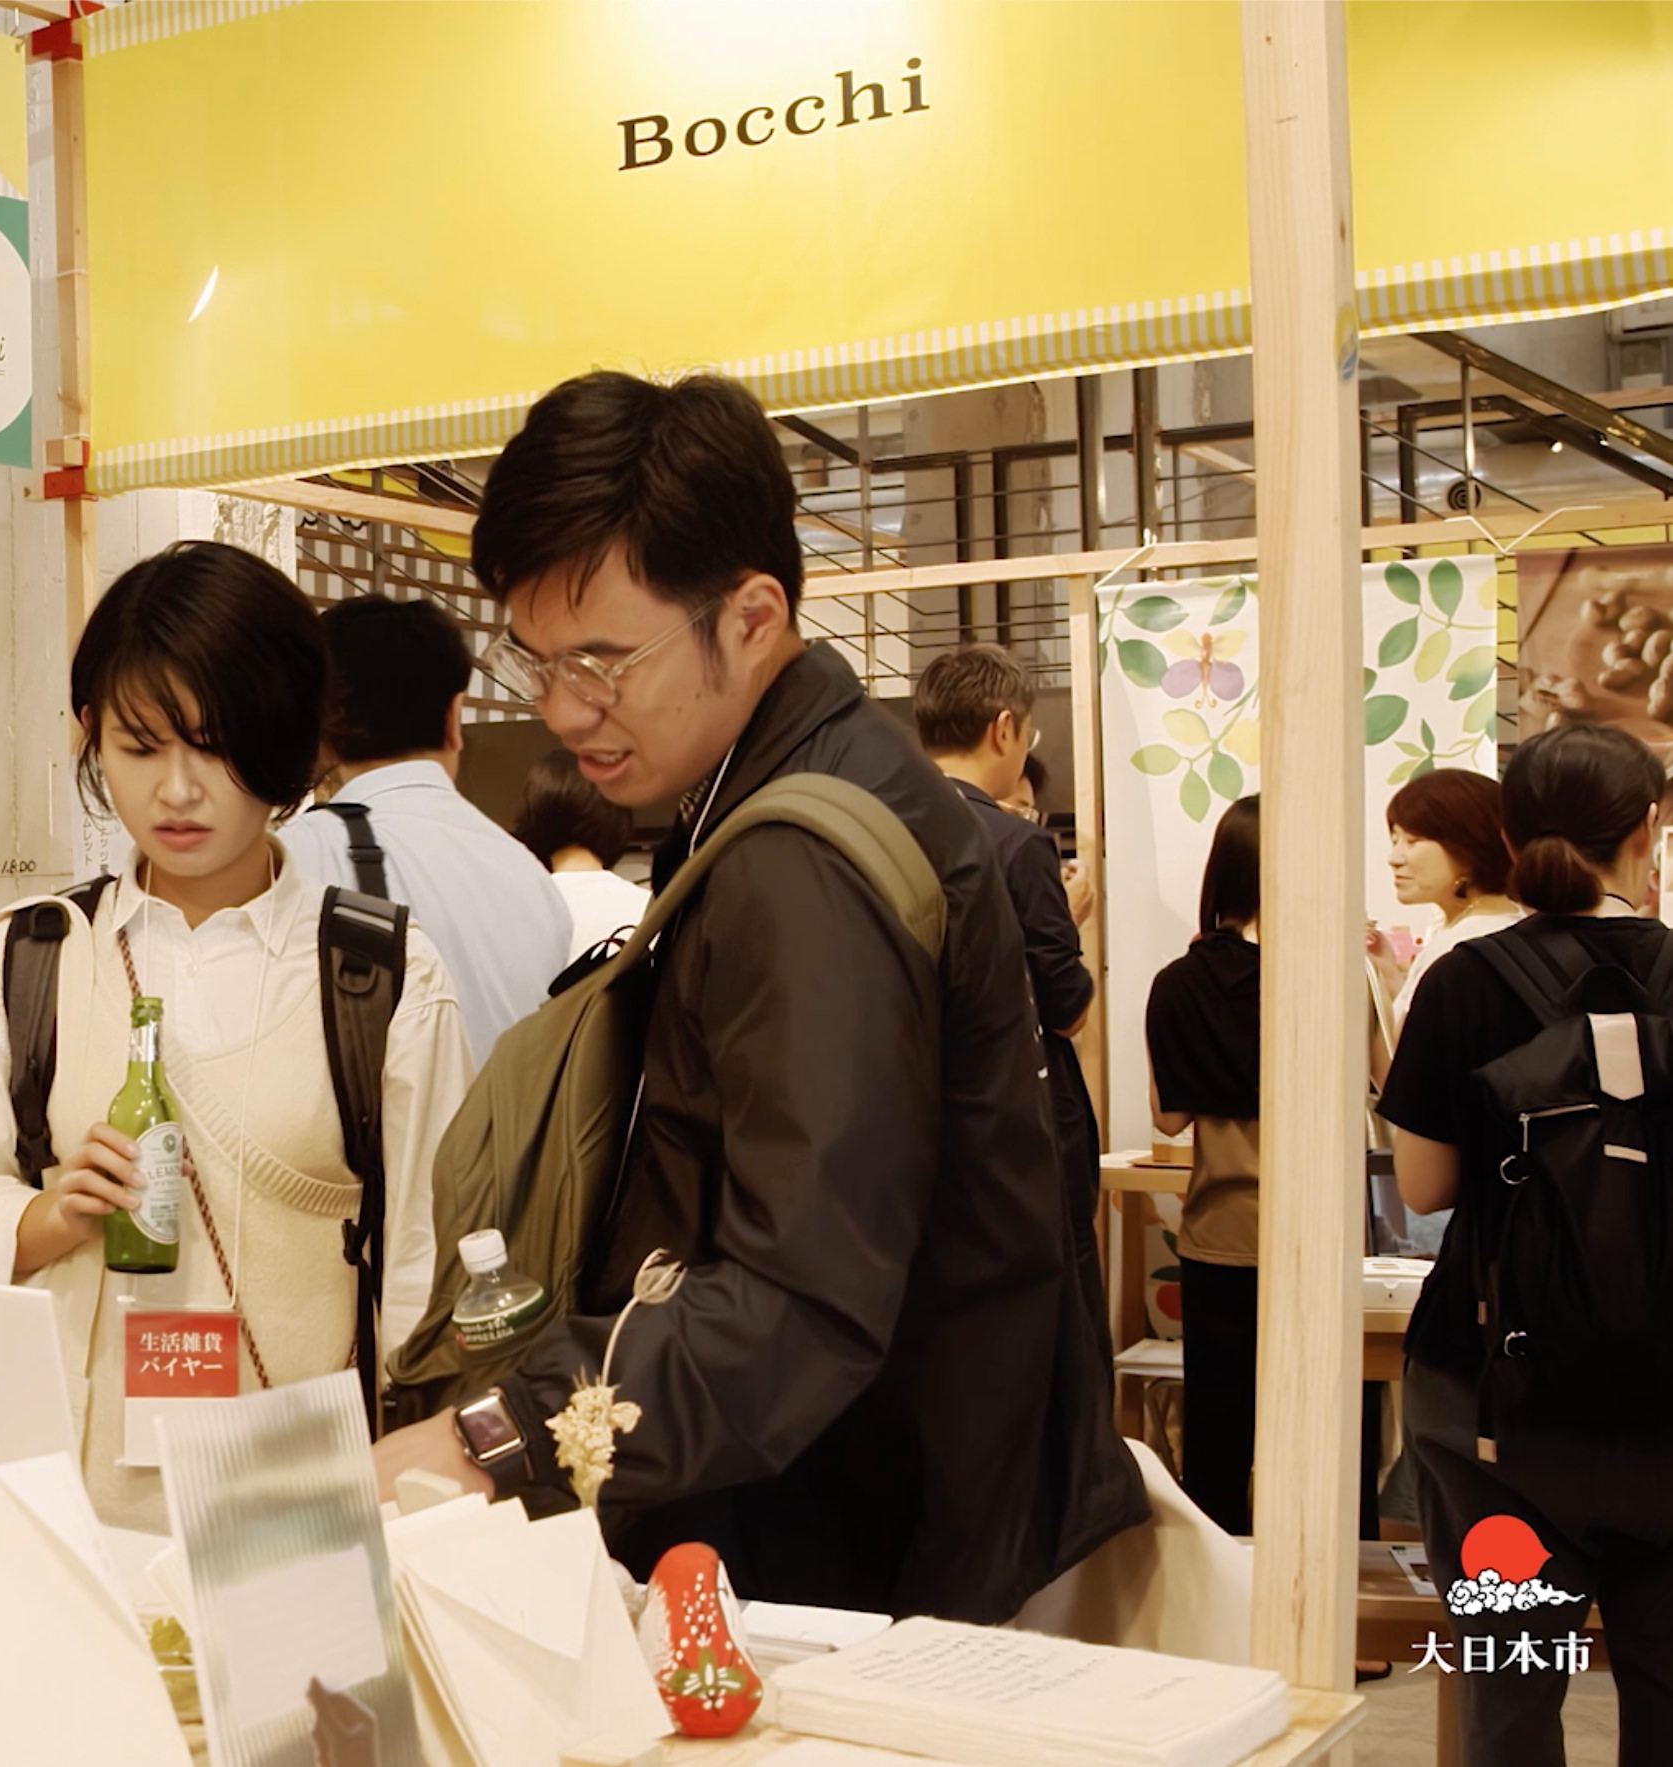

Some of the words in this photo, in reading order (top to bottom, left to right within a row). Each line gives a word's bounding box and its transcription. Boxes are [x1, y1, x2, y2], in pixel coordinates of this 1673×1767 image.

[617, 57, 930, 171] Bocchi
[139, 1331, 223, 1353] 生活雑貨
[139, 1357, 223, 1377] バイヤー
